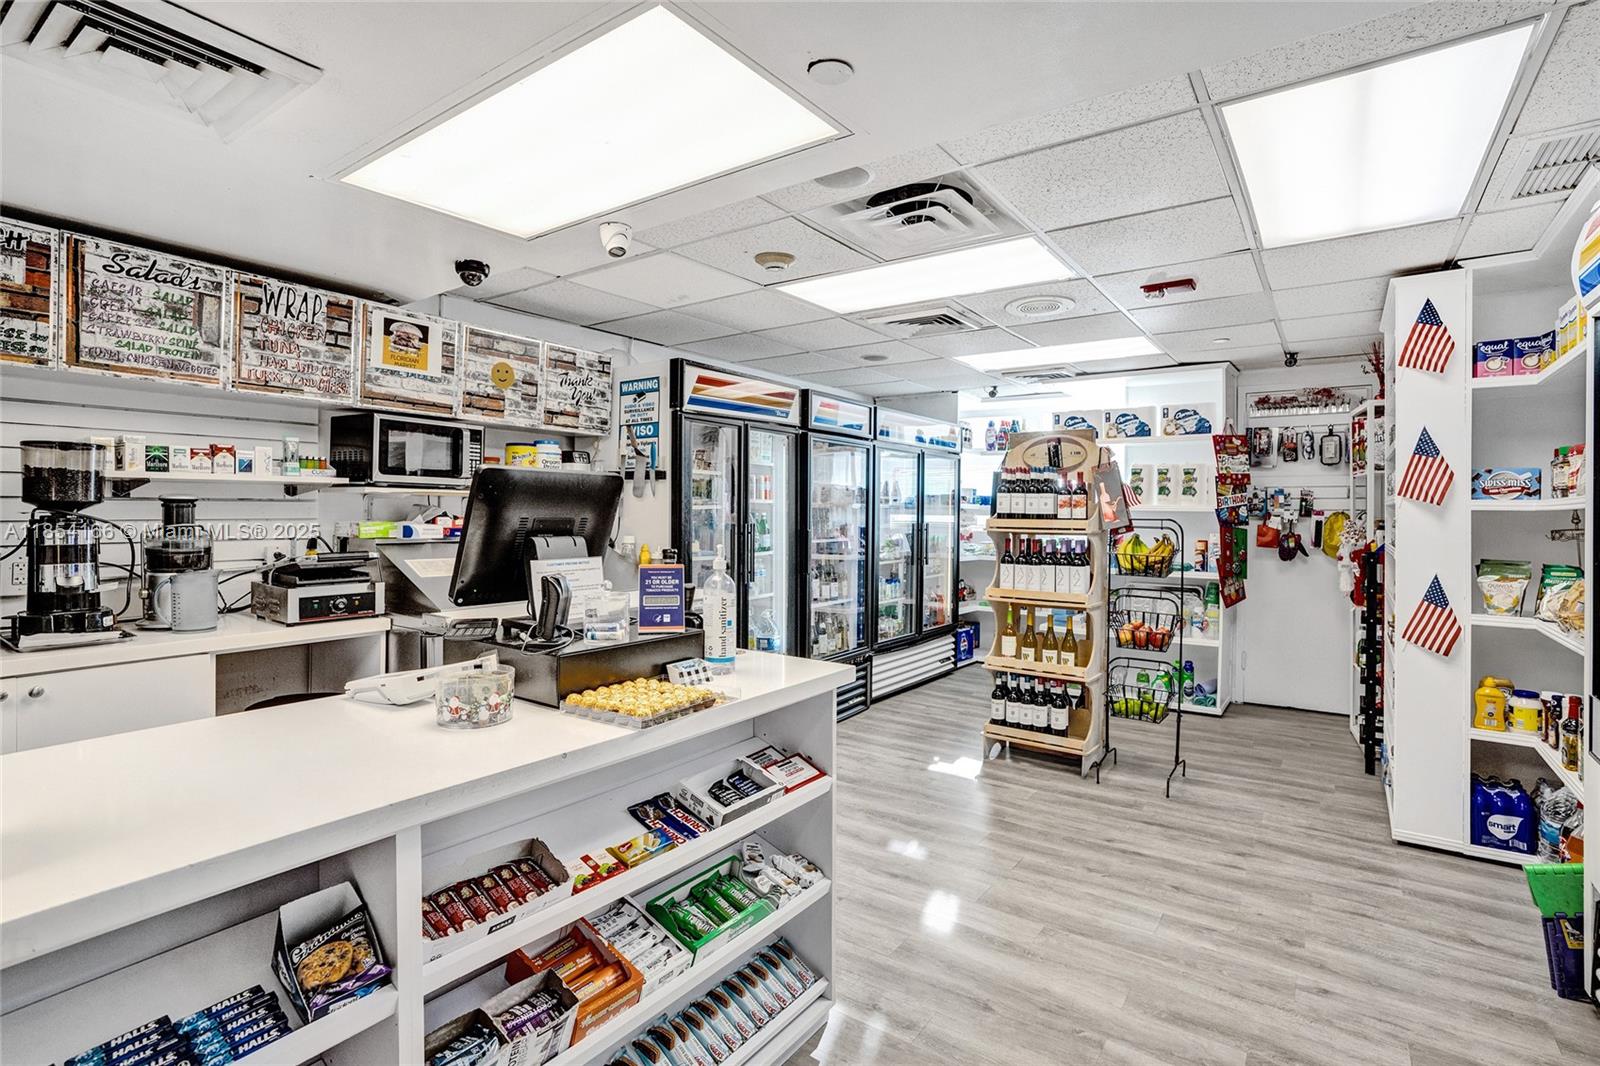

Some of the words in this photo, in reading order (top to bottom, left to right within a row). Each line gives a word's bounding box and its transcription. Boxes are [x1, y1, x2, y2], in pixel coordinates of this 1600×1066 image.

[103, 253, 200, 290] Salads
[153, 290, 193, 306] SALAD
[263, 284, 323, 324] WRAP
[159, 321, 198, 336] SALAD
[261, 318, 326, 344] CHICKEN
[115, 340, 152, 353] SALAD
[1479, 341, 1509, 353] equal
[560, 371, 593, 388] Thank
[621, 379, 659, 393] WARNING
[632, 425, 654, 437] VISO
[146, 460, 168, 468] Marlboro
[719, 597, 728, 636] sanitizer
[719, 635, 728, 659] hand
[648, 819, 687, 845] CRUNCH
[670, 808, 708, 836] CRUNCH
[1488, 820, 1517, 832] smart
[211, 990, 253, 1012] HALLS
[226, 1008, 268, 1031] HALLS
[234, 1018, 276, 1041] HALLS
[110, 1021, 160, 1048] HALLS
[112, 1032, 162, 1059] HALLS
[238, 1029, 281, 1053] HALLS
